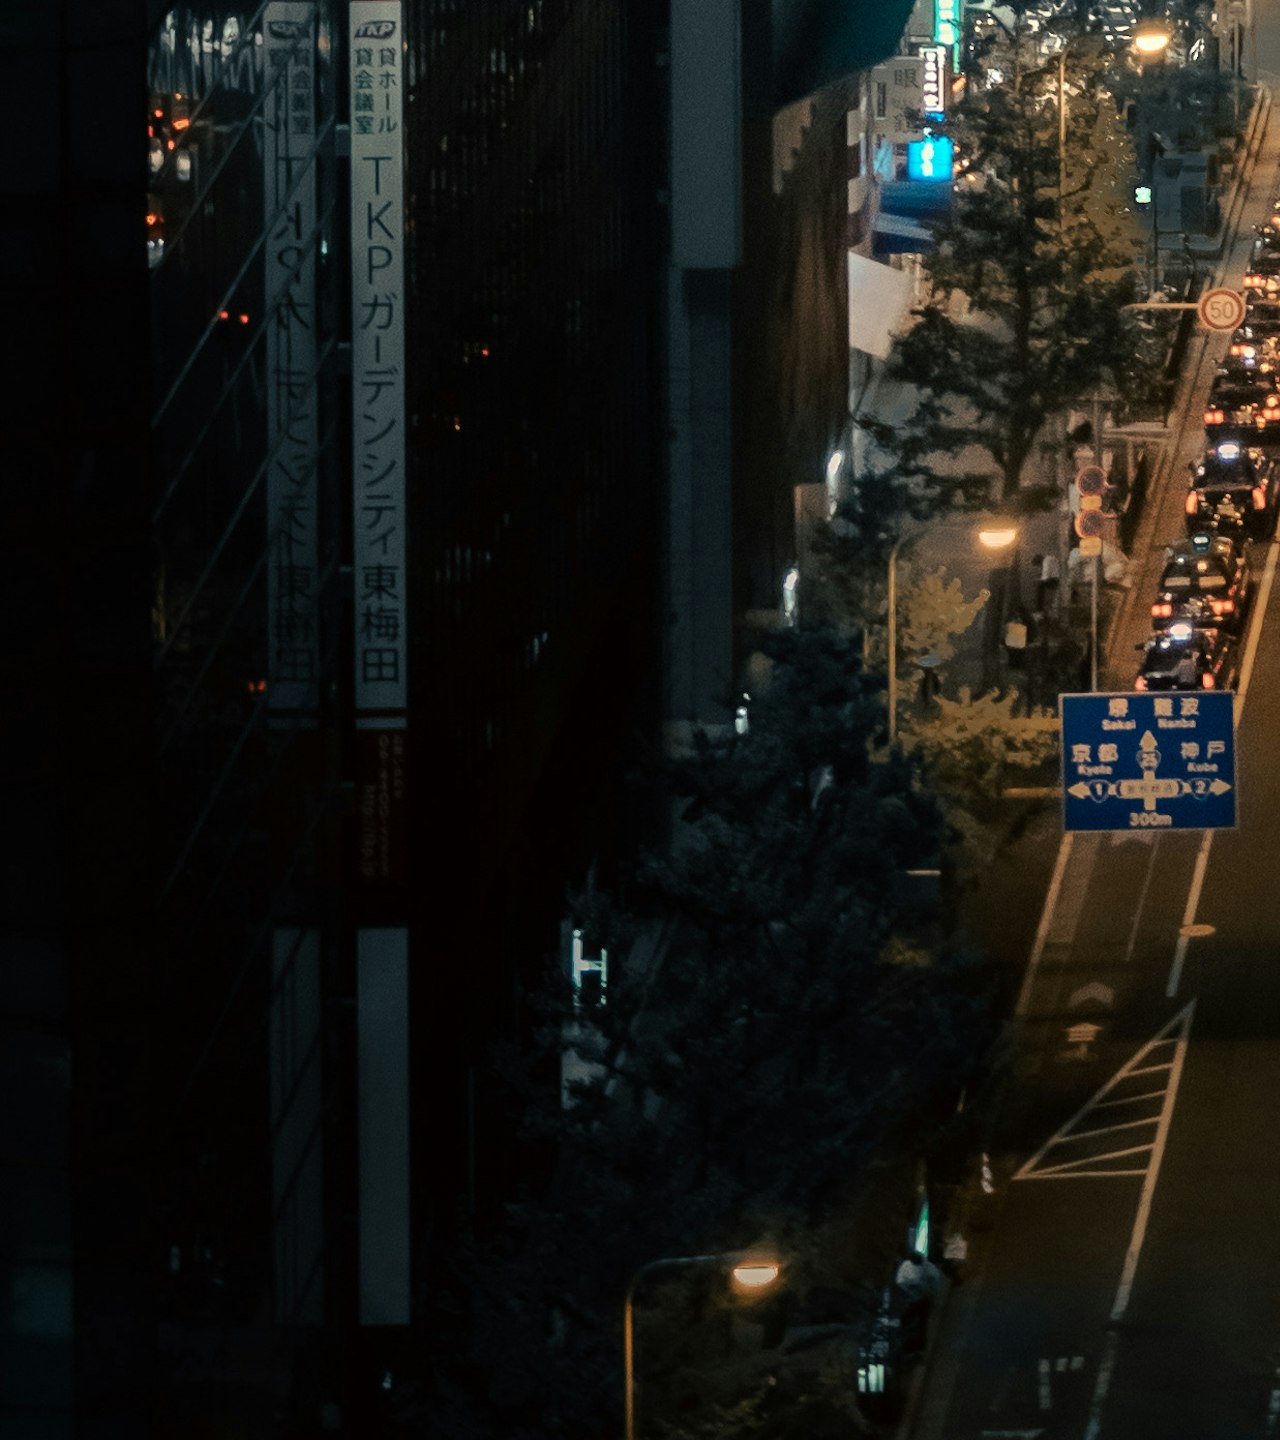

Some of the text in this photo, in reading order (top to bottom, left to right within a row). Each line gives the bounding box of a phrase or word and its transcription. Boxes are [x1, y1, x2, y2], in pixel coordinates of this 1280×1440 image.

[355, 46, 374, 135] 貸会議室
[379, 47, 397, 134] 貸ホール
[1210, 300, 1234, 319] 50
[362, 156, 399, 683] TKPガーデンシティ東梅田
[1129, 812, 1172, 827] 300m
